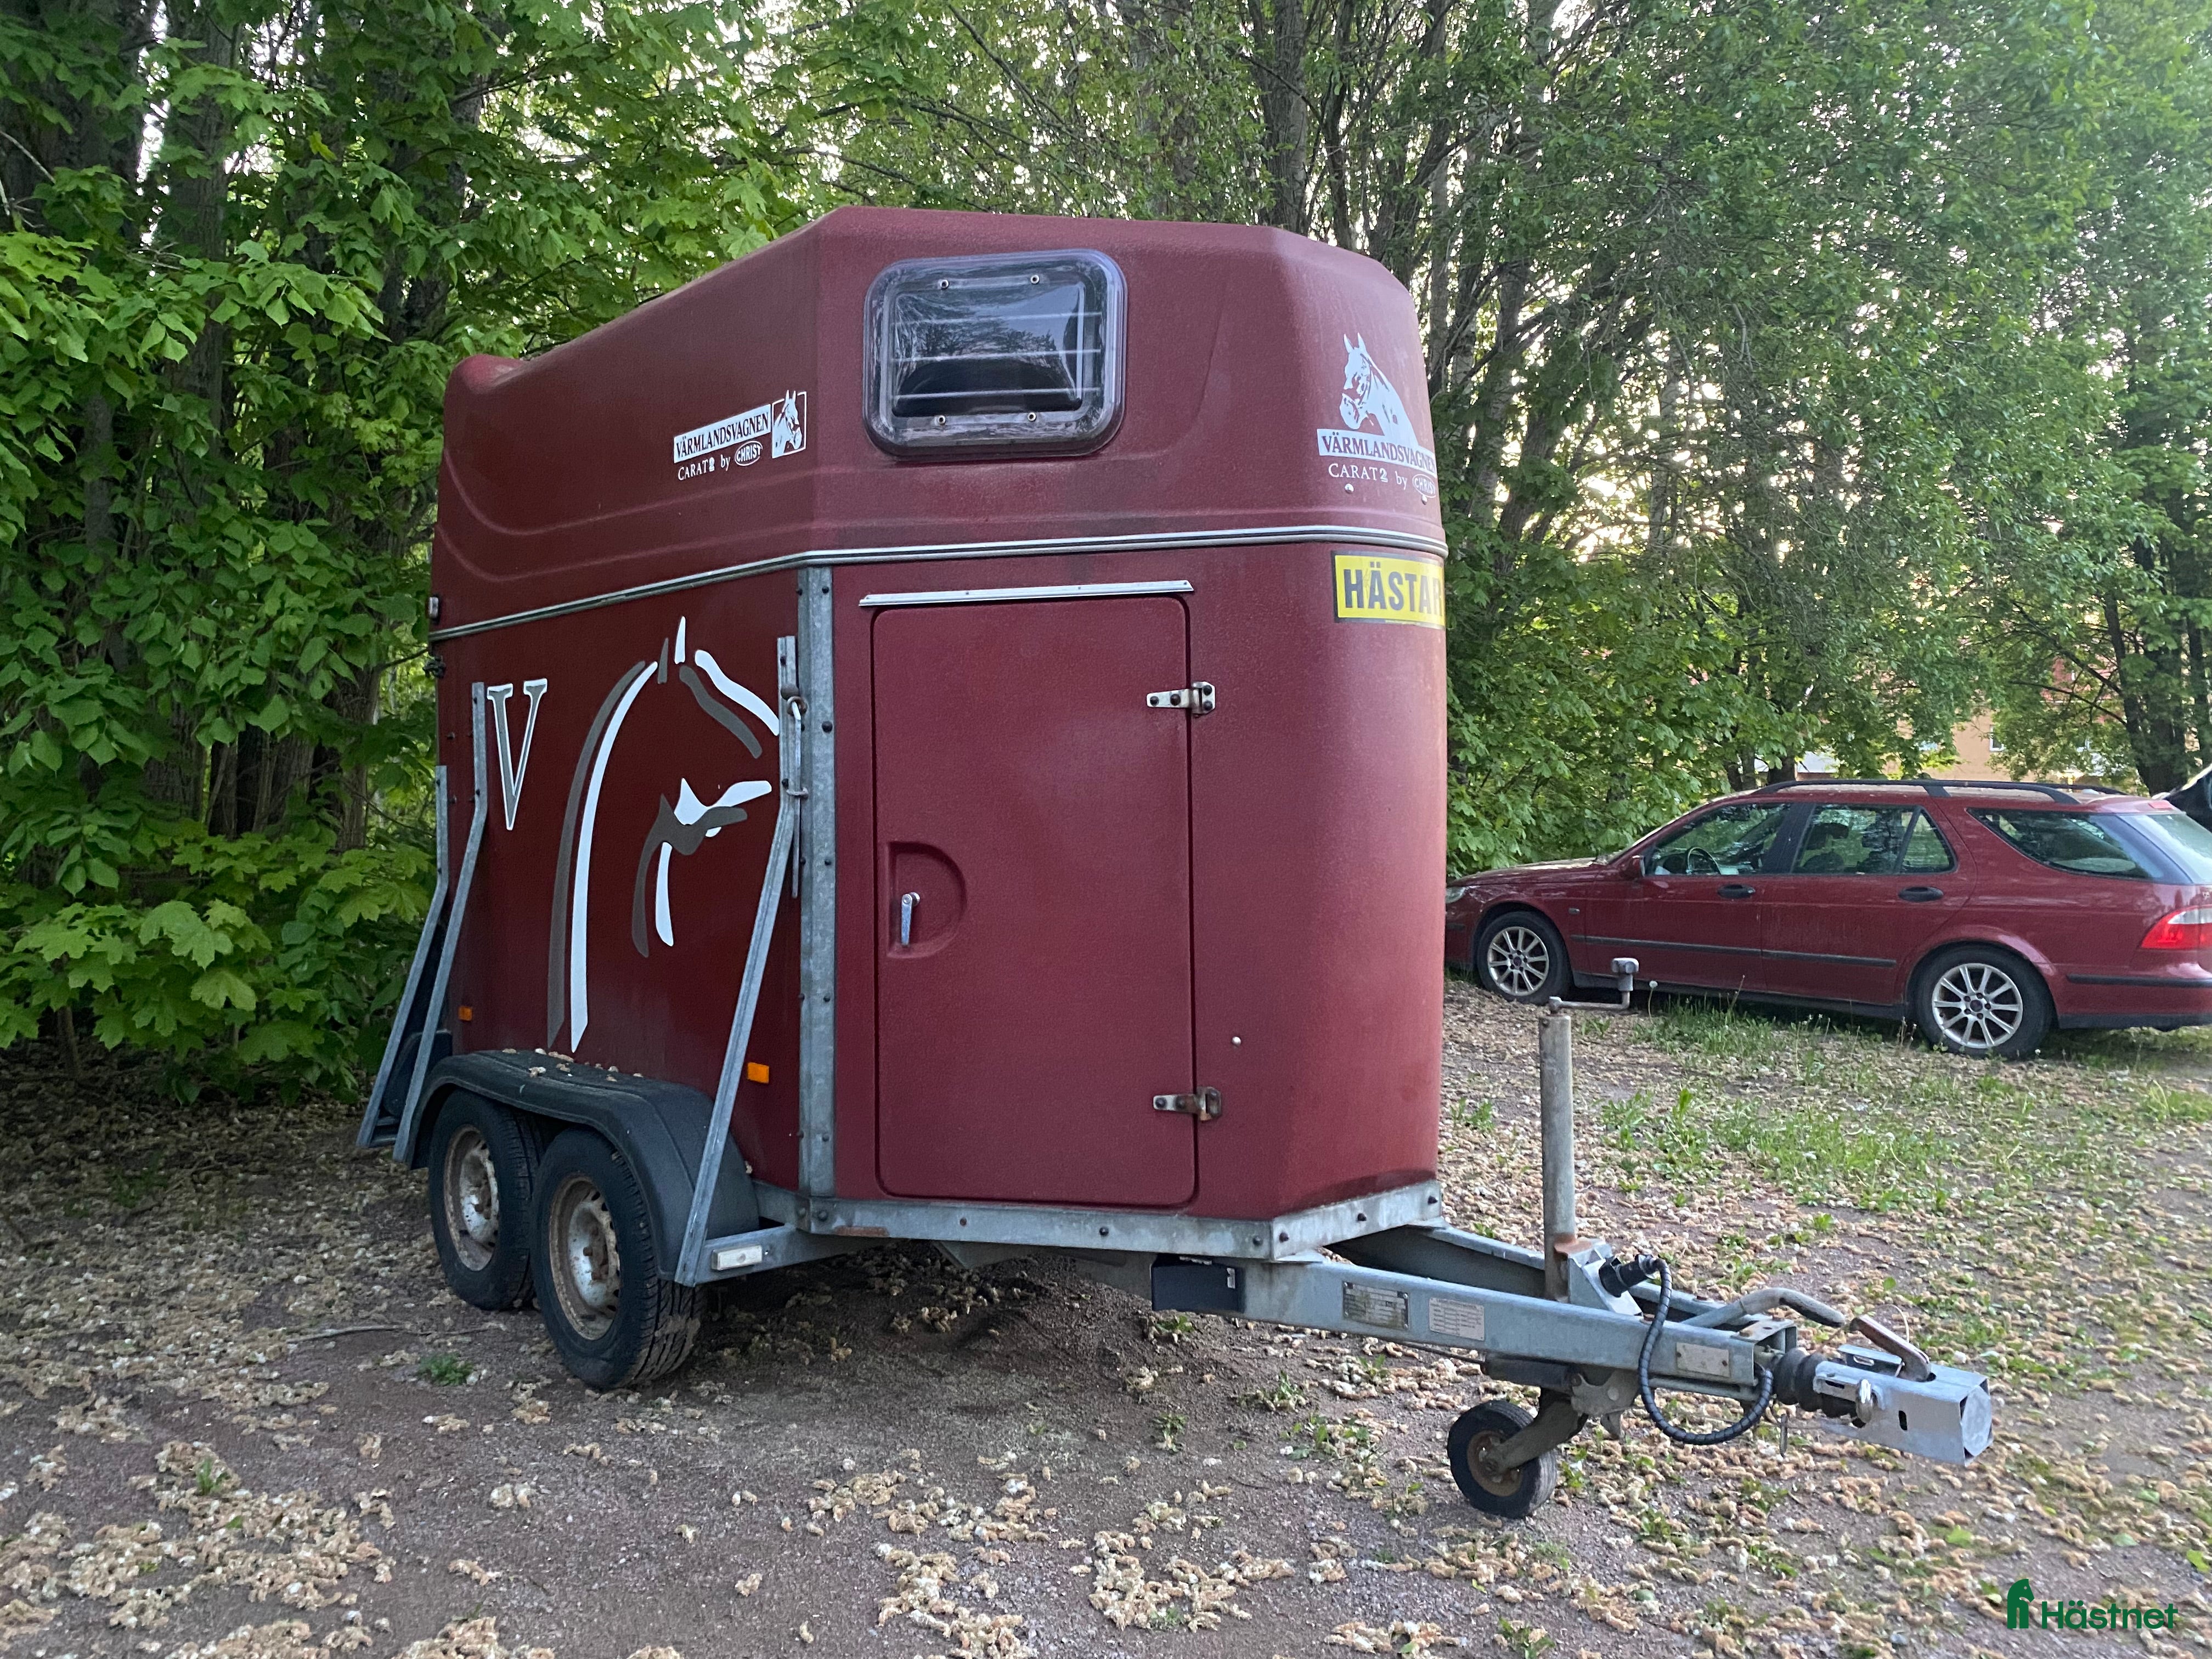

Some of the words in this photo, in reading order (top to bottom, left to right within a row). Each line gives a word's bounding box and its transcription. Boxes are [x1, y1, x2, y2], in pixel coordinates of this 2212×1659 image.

[676, 411, 769, 459] VÄRMLANDSVAGNEN
[720, 454, 731, 471] by
[736, 444, 761, 462] CHRIST
[1328, 463, 1389, 483] CARAT2
[1395, 471, 1408, 490] by
[487, 678, 548, 830] V
